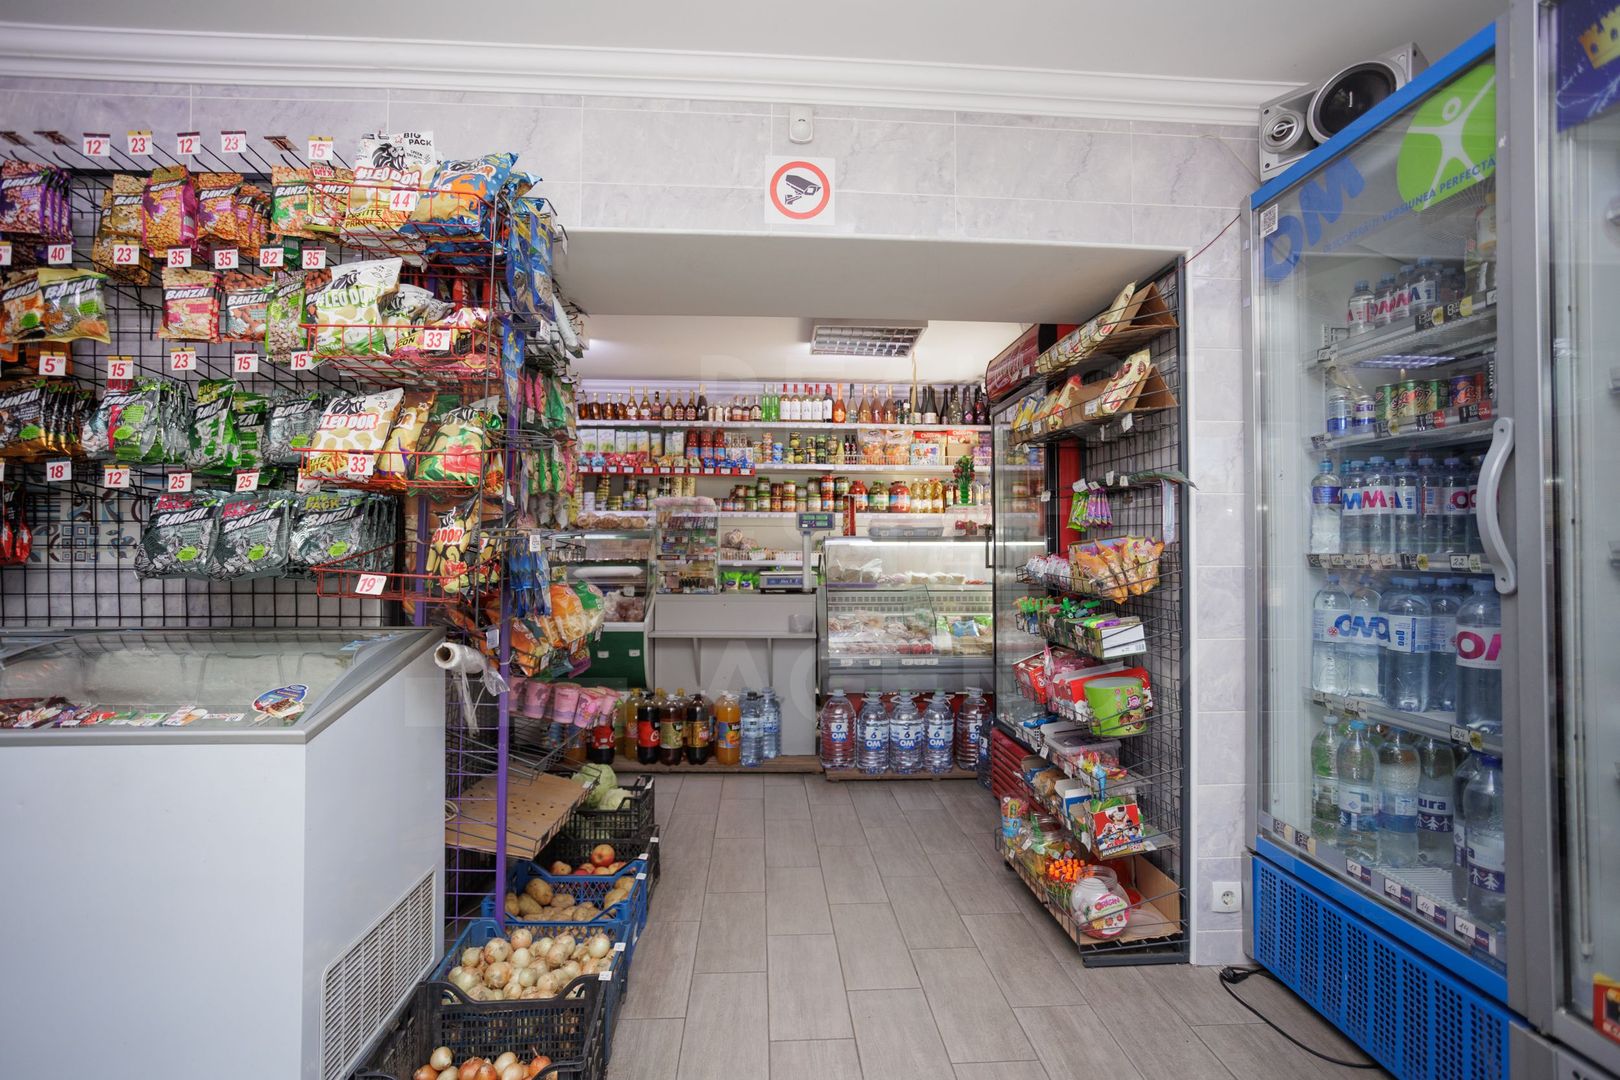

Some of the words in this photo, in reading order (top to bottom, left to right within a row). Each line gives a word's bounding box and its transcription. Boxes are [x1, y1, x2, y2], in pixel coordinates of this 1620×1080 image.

[86, 140, 102, 155] 12
[131, 138, 146, 153] 23
[179, 138, 193, 153] 12
[224, 137, 239, 150] 23
[311, 143, 326, 158] 15
[408, 139, 432, 147] PACK
[392, 193, 410, 208] 44
[50, 246, 65, 261] 40
[116, 247, 132, 262] 23
[170, 250, 185, 265] 35
[218, 251, 232, 266] 35
[262, 250, 277, 264] 82
[305, 251, 320, 266] 35
[165, 288, 209, 300] BANZAI
[227, 293, 268, 305] BANZAI
[426, 332, 442, 348] 33
[44, 357, 55, 373] 5
[174, 354, 189, 369] 23
[238, 356, 252, 370] 15
[293, 354, 307, 368] 15
[111, 363, 126, 377] 15
[49, 465, 64, 479] 18
[350, 456, 366, 473] 33
[107, 471, 122, 484] 12
[170, 476, 186, 489] 25
[238, 475, 253, 489] 25
[157, 507, 209, 527] BANZAI
[224, 509, 273, 533] BANZAI
[308, 508, 356, 527] BANZAI
[1452, 558, 1465, 567] 22
[359, 577, 376, 592] 19
[831, 732, 847, 740] OM
[1453, 729, 1465, 740] 24
